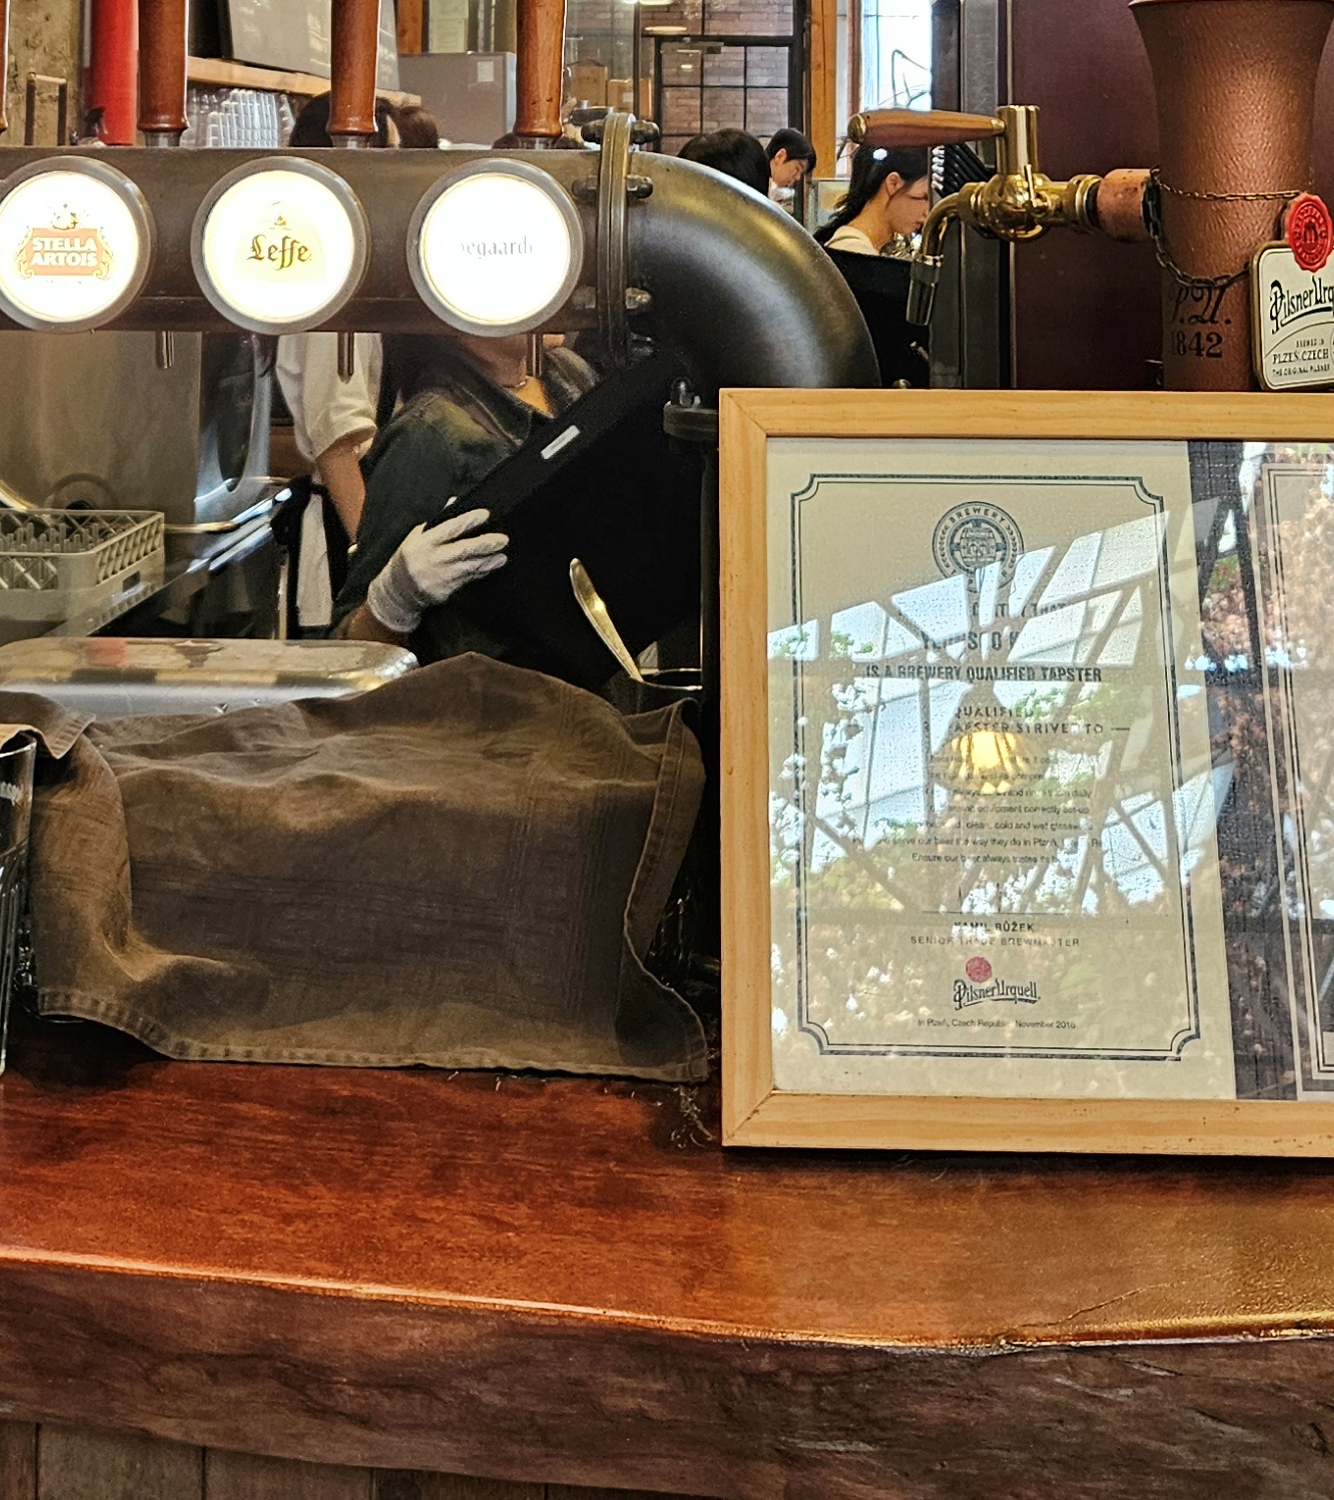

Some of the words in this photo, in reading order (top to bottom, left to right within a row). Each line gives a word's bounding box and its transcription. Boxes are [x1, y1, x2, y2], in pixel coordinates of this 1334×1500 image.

[32, 237, 98, 251] STELLA
[246, 233, 312, 271] Leffe
[30, 251, 98, 267] ARTOIS
[949, 506, 1006, 523] BREWERY
[898, 666, 960, 681] BREWERY
[966, 666, 1036, 682] QUALIFIED
[1041, 667, 1102, 683] TAPSTER
